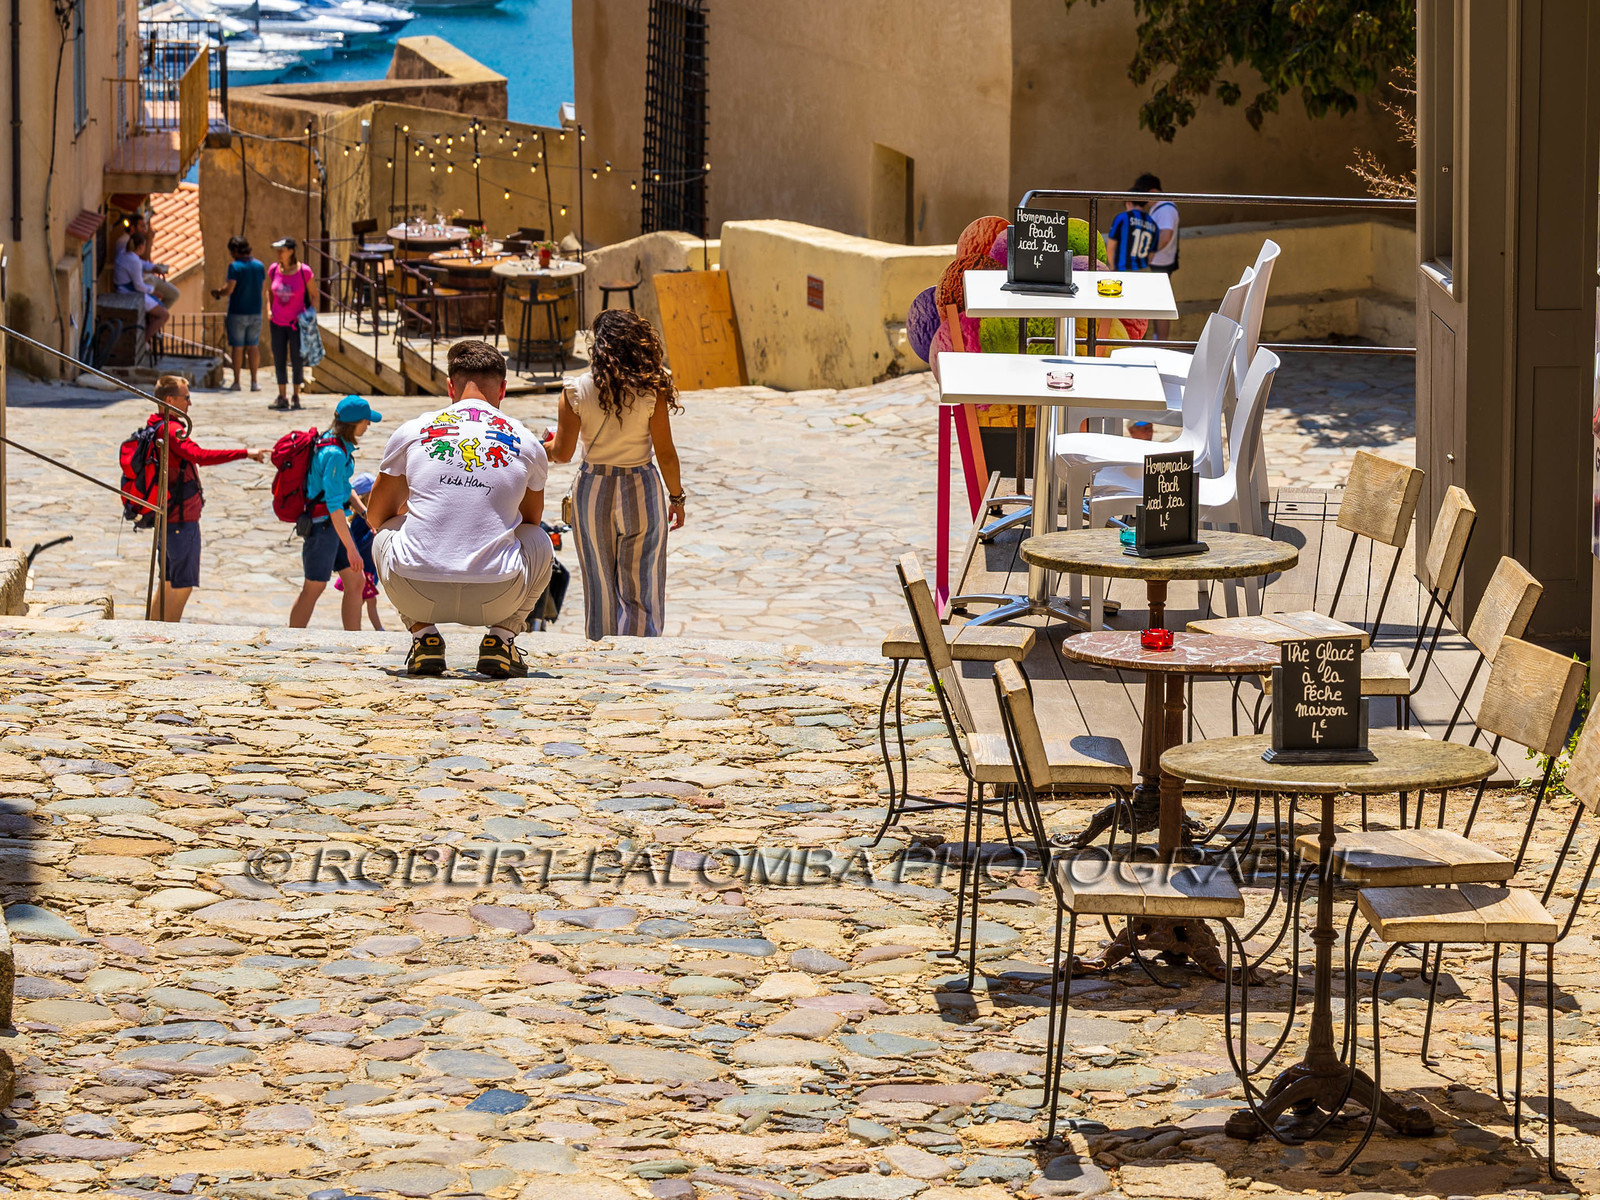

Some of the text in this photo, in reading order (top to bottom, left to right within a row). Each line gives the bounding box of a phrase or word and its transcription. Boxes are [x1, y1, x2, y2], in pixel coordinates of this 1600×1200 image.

[1028, 222, 1056, 239] Peach
[1017, 236, 1060, 253] iced tea
[1131, 228, 1153, 259] 10
[1145, 456, 1191, 475] Homemade
[1157, 474, 1180, 493] Peach
[1145, 494, 1185, 511] iced tea
[1282, 641, 1310, 663] Thé
[1301, 665, 1345, 685] à la
[1303, 684, 1343, 701] Pêche
